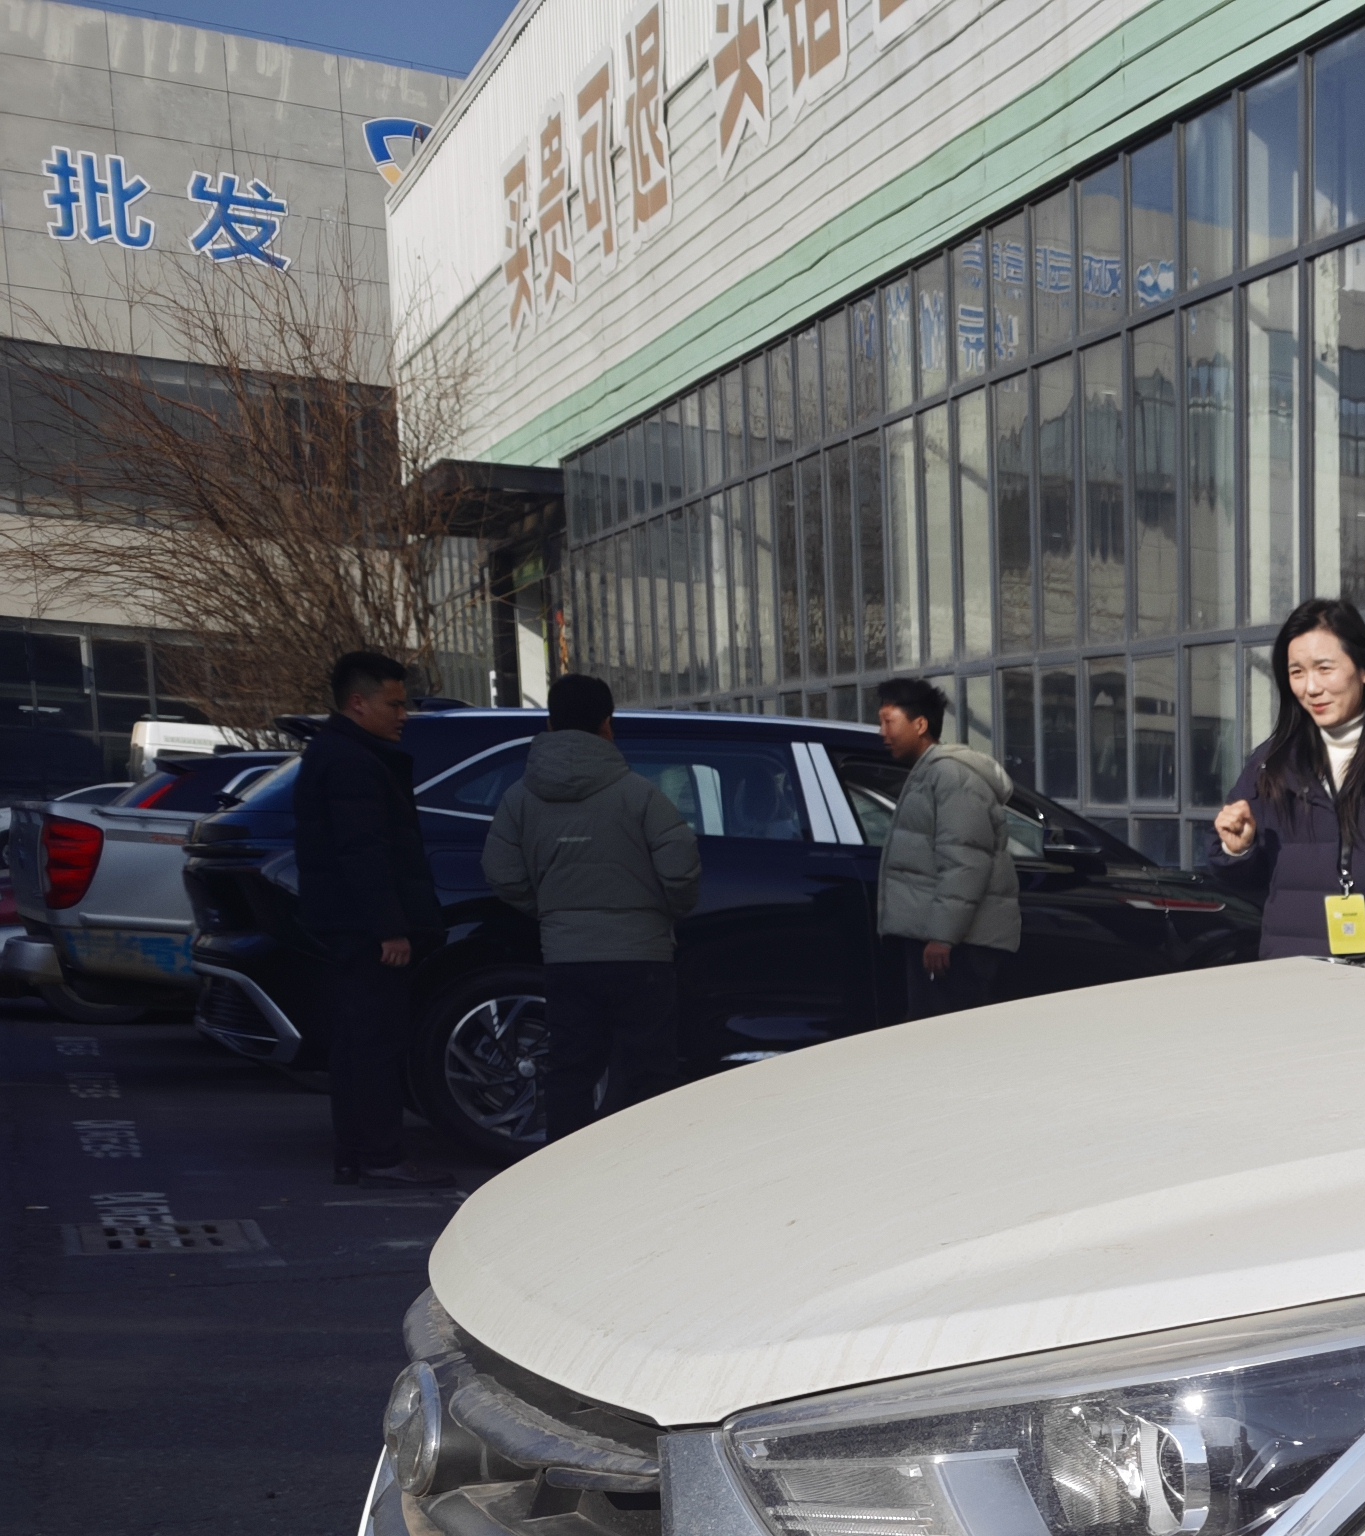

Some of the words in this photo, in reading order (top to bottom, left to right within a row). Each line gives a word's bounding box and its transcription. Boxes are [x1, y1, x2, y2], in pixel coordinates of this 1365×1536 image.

[43, 146, 291, 272] 批发
[503, 3, 668, 336] 买贵可退
